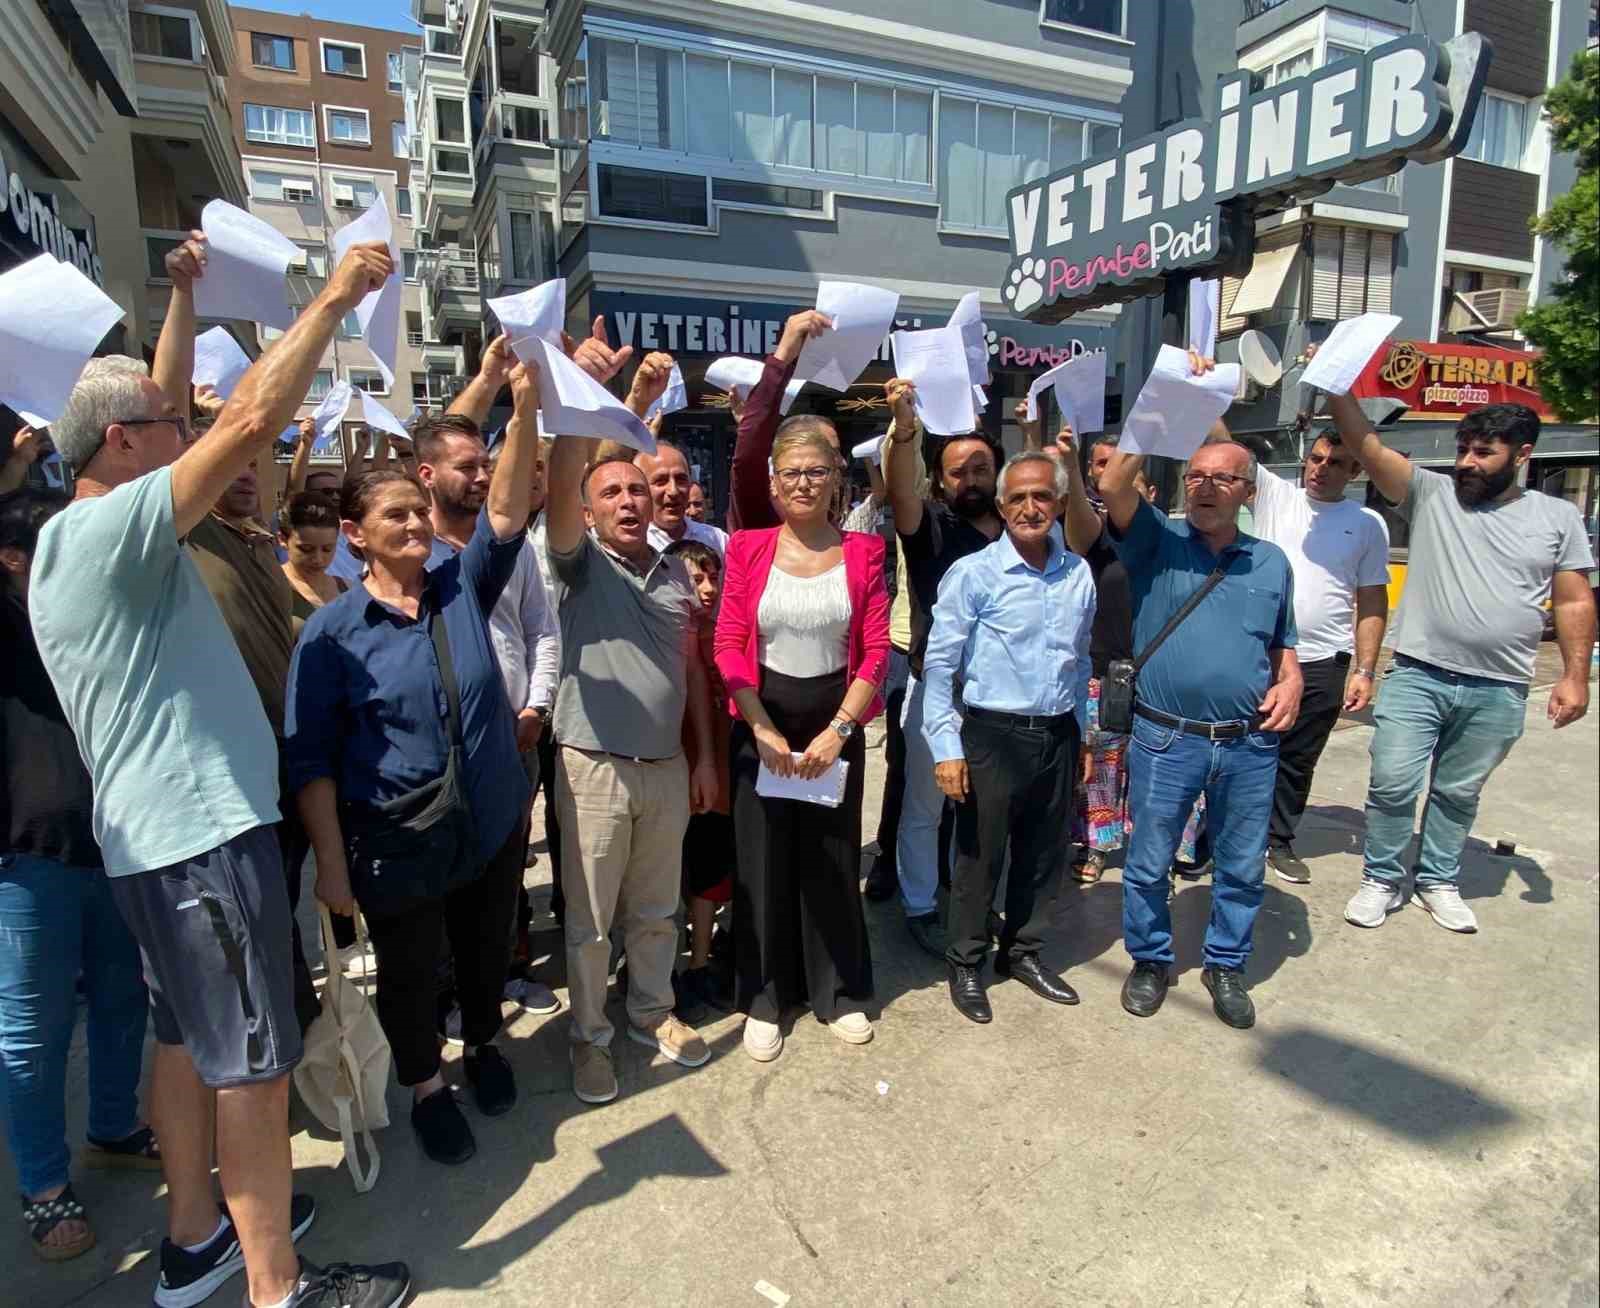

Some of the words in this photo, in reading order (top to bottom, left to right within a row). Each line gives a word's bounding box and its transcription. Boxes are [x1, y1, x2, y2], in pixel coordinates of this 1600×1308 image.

[1011, 48, 1429, 256] VETERİNER
[614, 305, 780, 354] VETERİNE
[1427, 354, 1507, 385] TERRA
